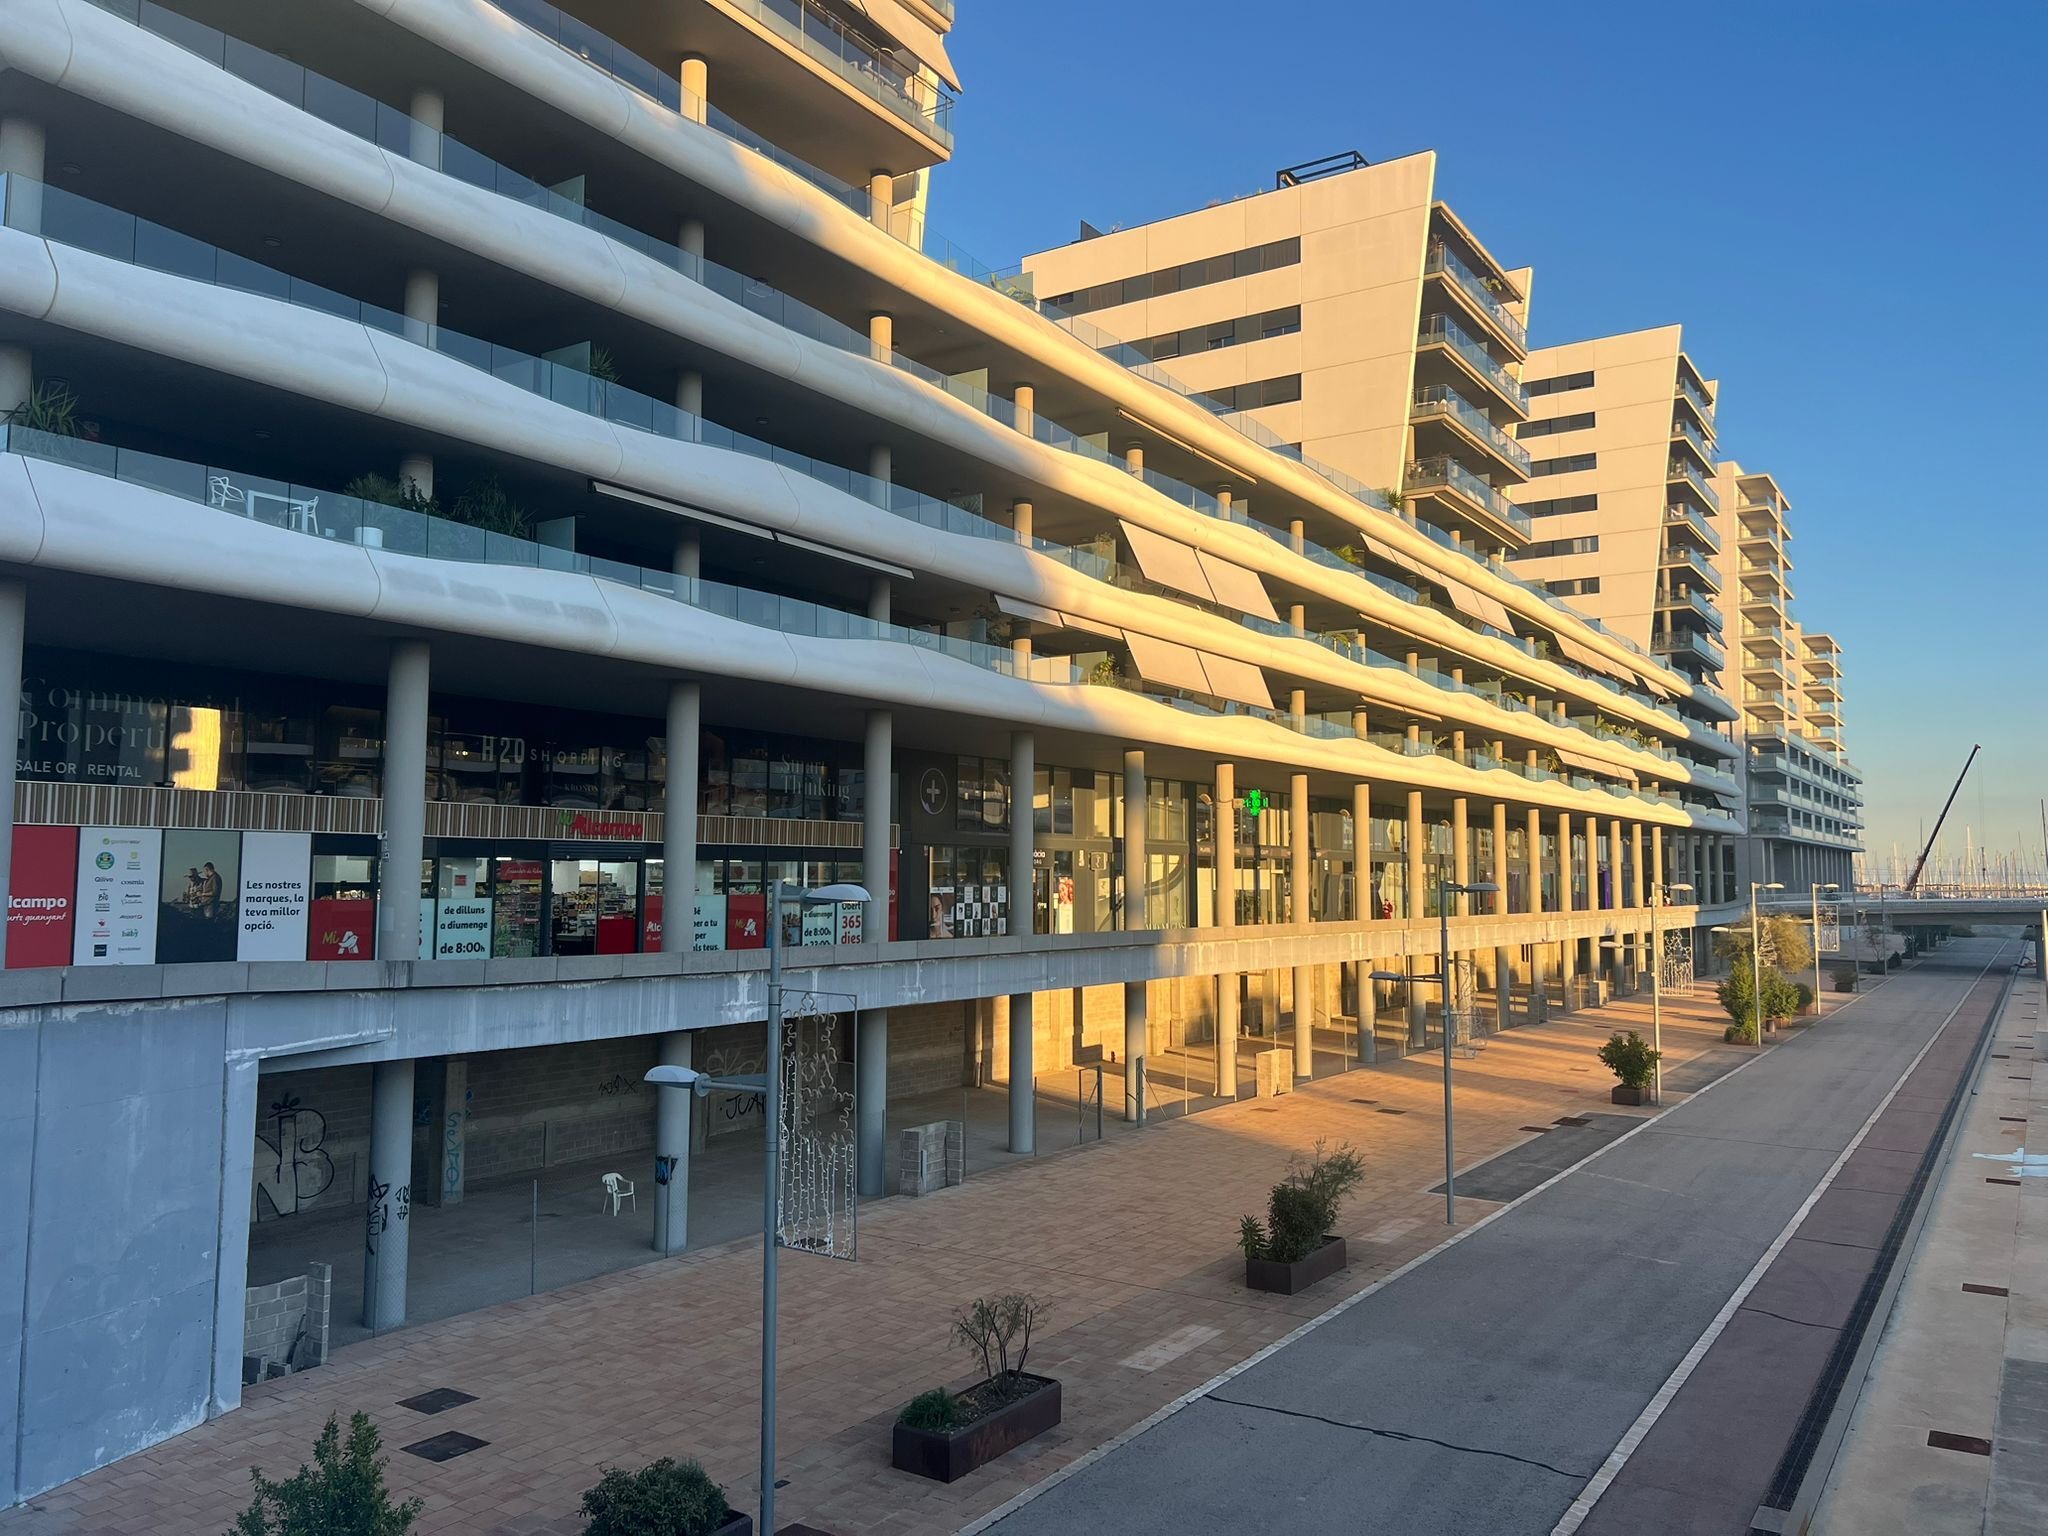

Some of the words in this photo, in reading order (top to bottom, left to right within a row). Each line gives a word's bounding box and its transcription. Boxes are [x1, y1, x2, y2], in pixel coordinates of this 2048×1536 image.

[15, 759, 52, 774] SALE
[55, 762, 77, 775] OR
[87, 764, 142, 778] RENTAL
[246, 880, 263, 889] Les
[265, 881, 302, 889] nostres
[246, 894, 292, 905] marques,
[294, 893, 304, 903] la
[245, 907, 268, 917] teva
[270, 906, 301, 916] millor
[444, 906, 455, 915] de
[456, 905, 486, 915] dilluns
[244, 920, 275, 932] opció.
[447, 922, 488, 931] diumenge
[710, 919, 718, 927] tu
[842, 915, 862, 929] 365
[695, 932, 707, 942] per
[804, 928, 813, 936] de
[813, 927, 832, 936] 8:00h
[841, 931, 861, 945] dies
[440, 942, 454, 954] de
[455, 942, 486, 954] 8:00h
